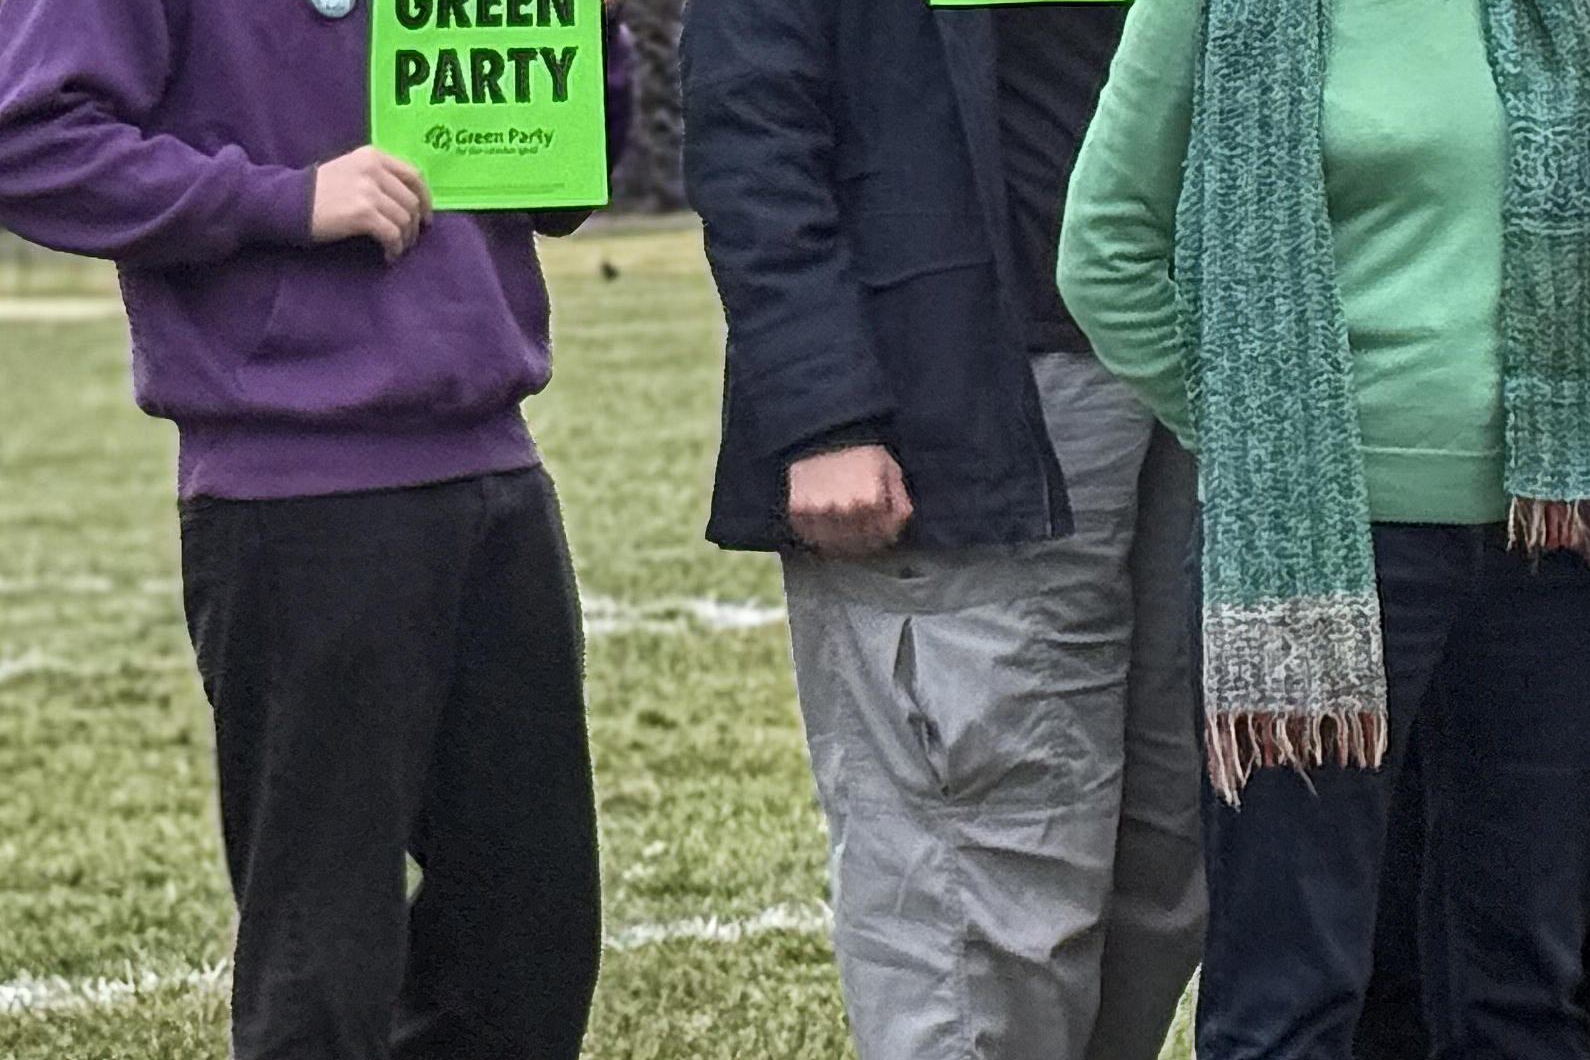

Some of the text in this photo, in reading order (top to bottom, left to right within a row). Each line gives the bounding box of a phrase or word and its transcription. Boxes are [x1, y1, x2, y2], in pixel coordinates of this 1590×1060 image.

[395, 46, 578, 105] PARTY
[455, 127, 555, 148] Green Party
